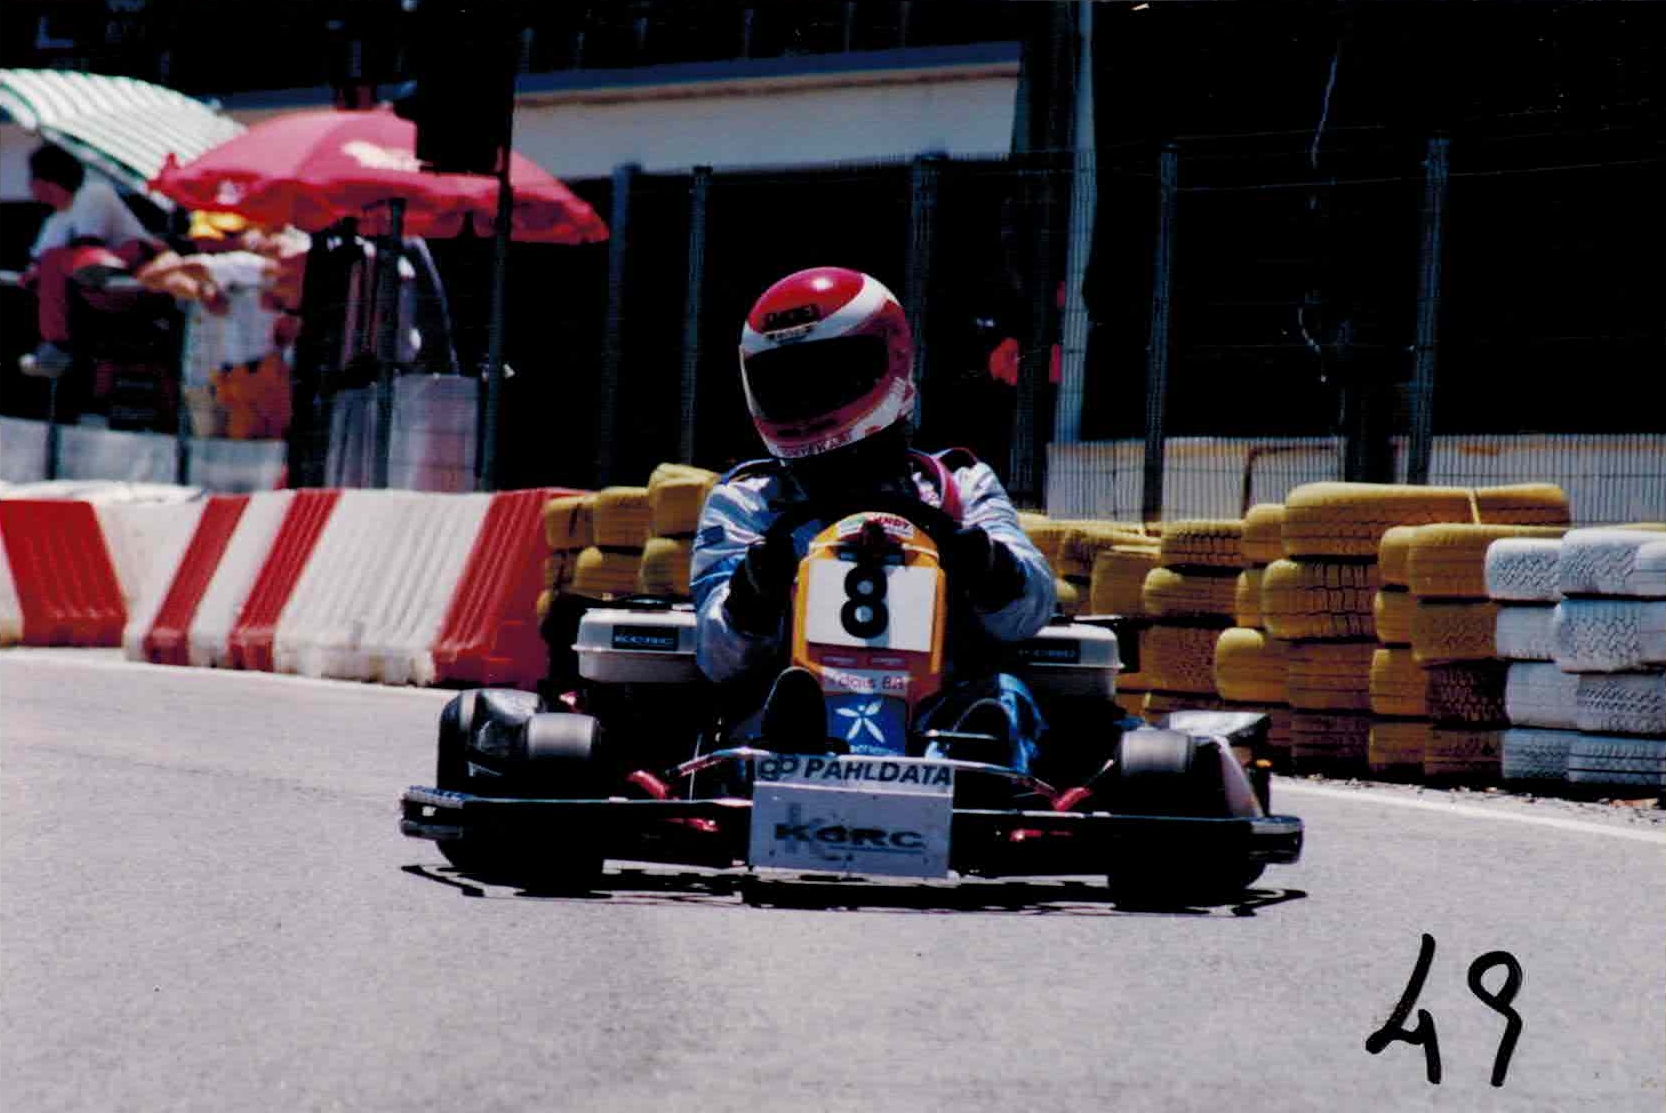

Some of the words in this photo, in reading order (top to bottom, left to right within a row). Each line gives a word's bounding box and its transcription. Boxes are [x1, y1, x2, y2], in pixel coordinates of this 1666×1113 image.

[840, 564, 889, 638] 8
[804, 757, 952, 786] PAHLDATA
[1365, 933, 1523, 1088] 49
